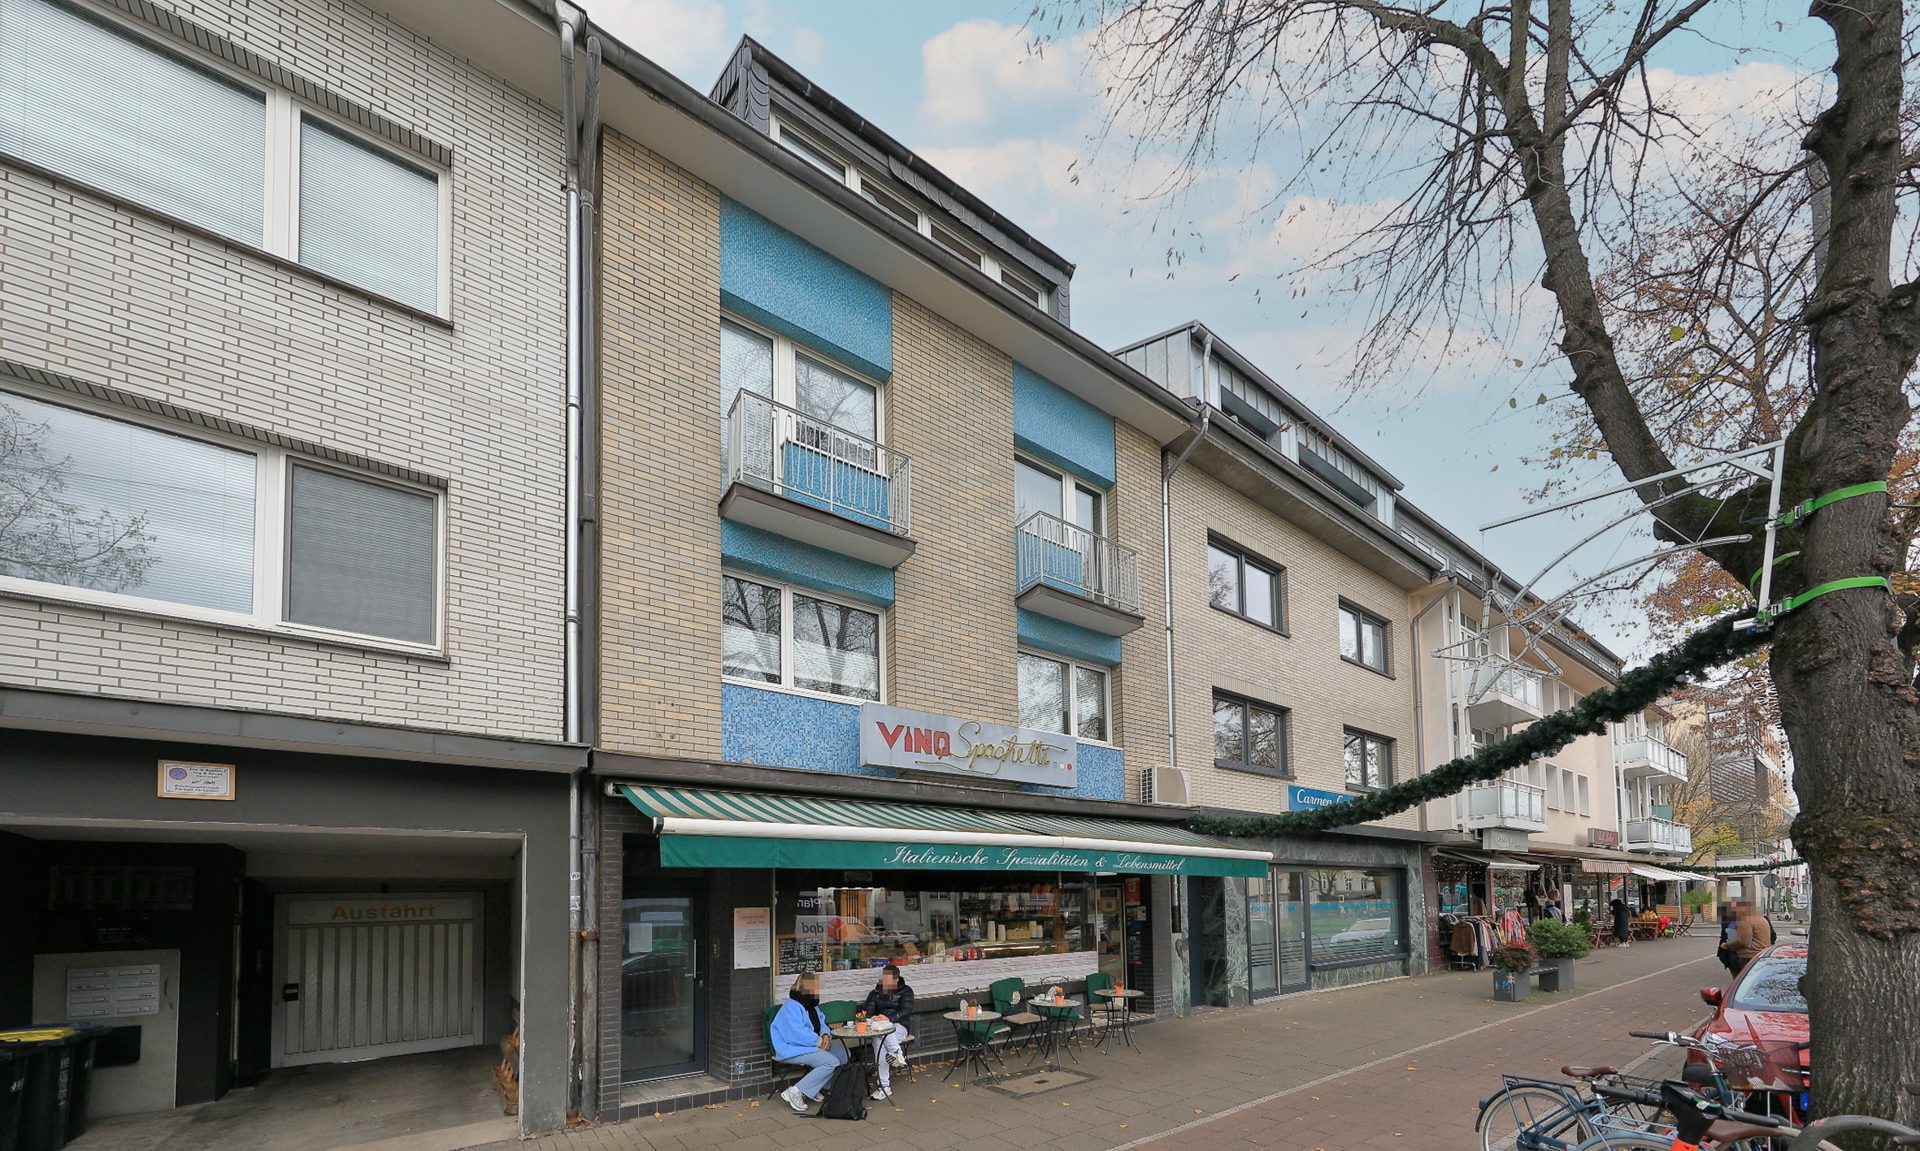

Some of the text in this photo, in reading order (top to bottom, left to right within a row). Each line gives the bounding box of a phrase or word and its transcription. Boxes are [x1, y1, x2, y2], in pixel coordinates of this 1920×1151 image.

[952, 721, 1066, 774] Spaghetti
[1297, 789, 1332, 806] Carmen
[884, 845, 1186, 871] Italienische Spezialitäten & Lebensmittel
[332, 903, 435, 920] Ausfahrt
